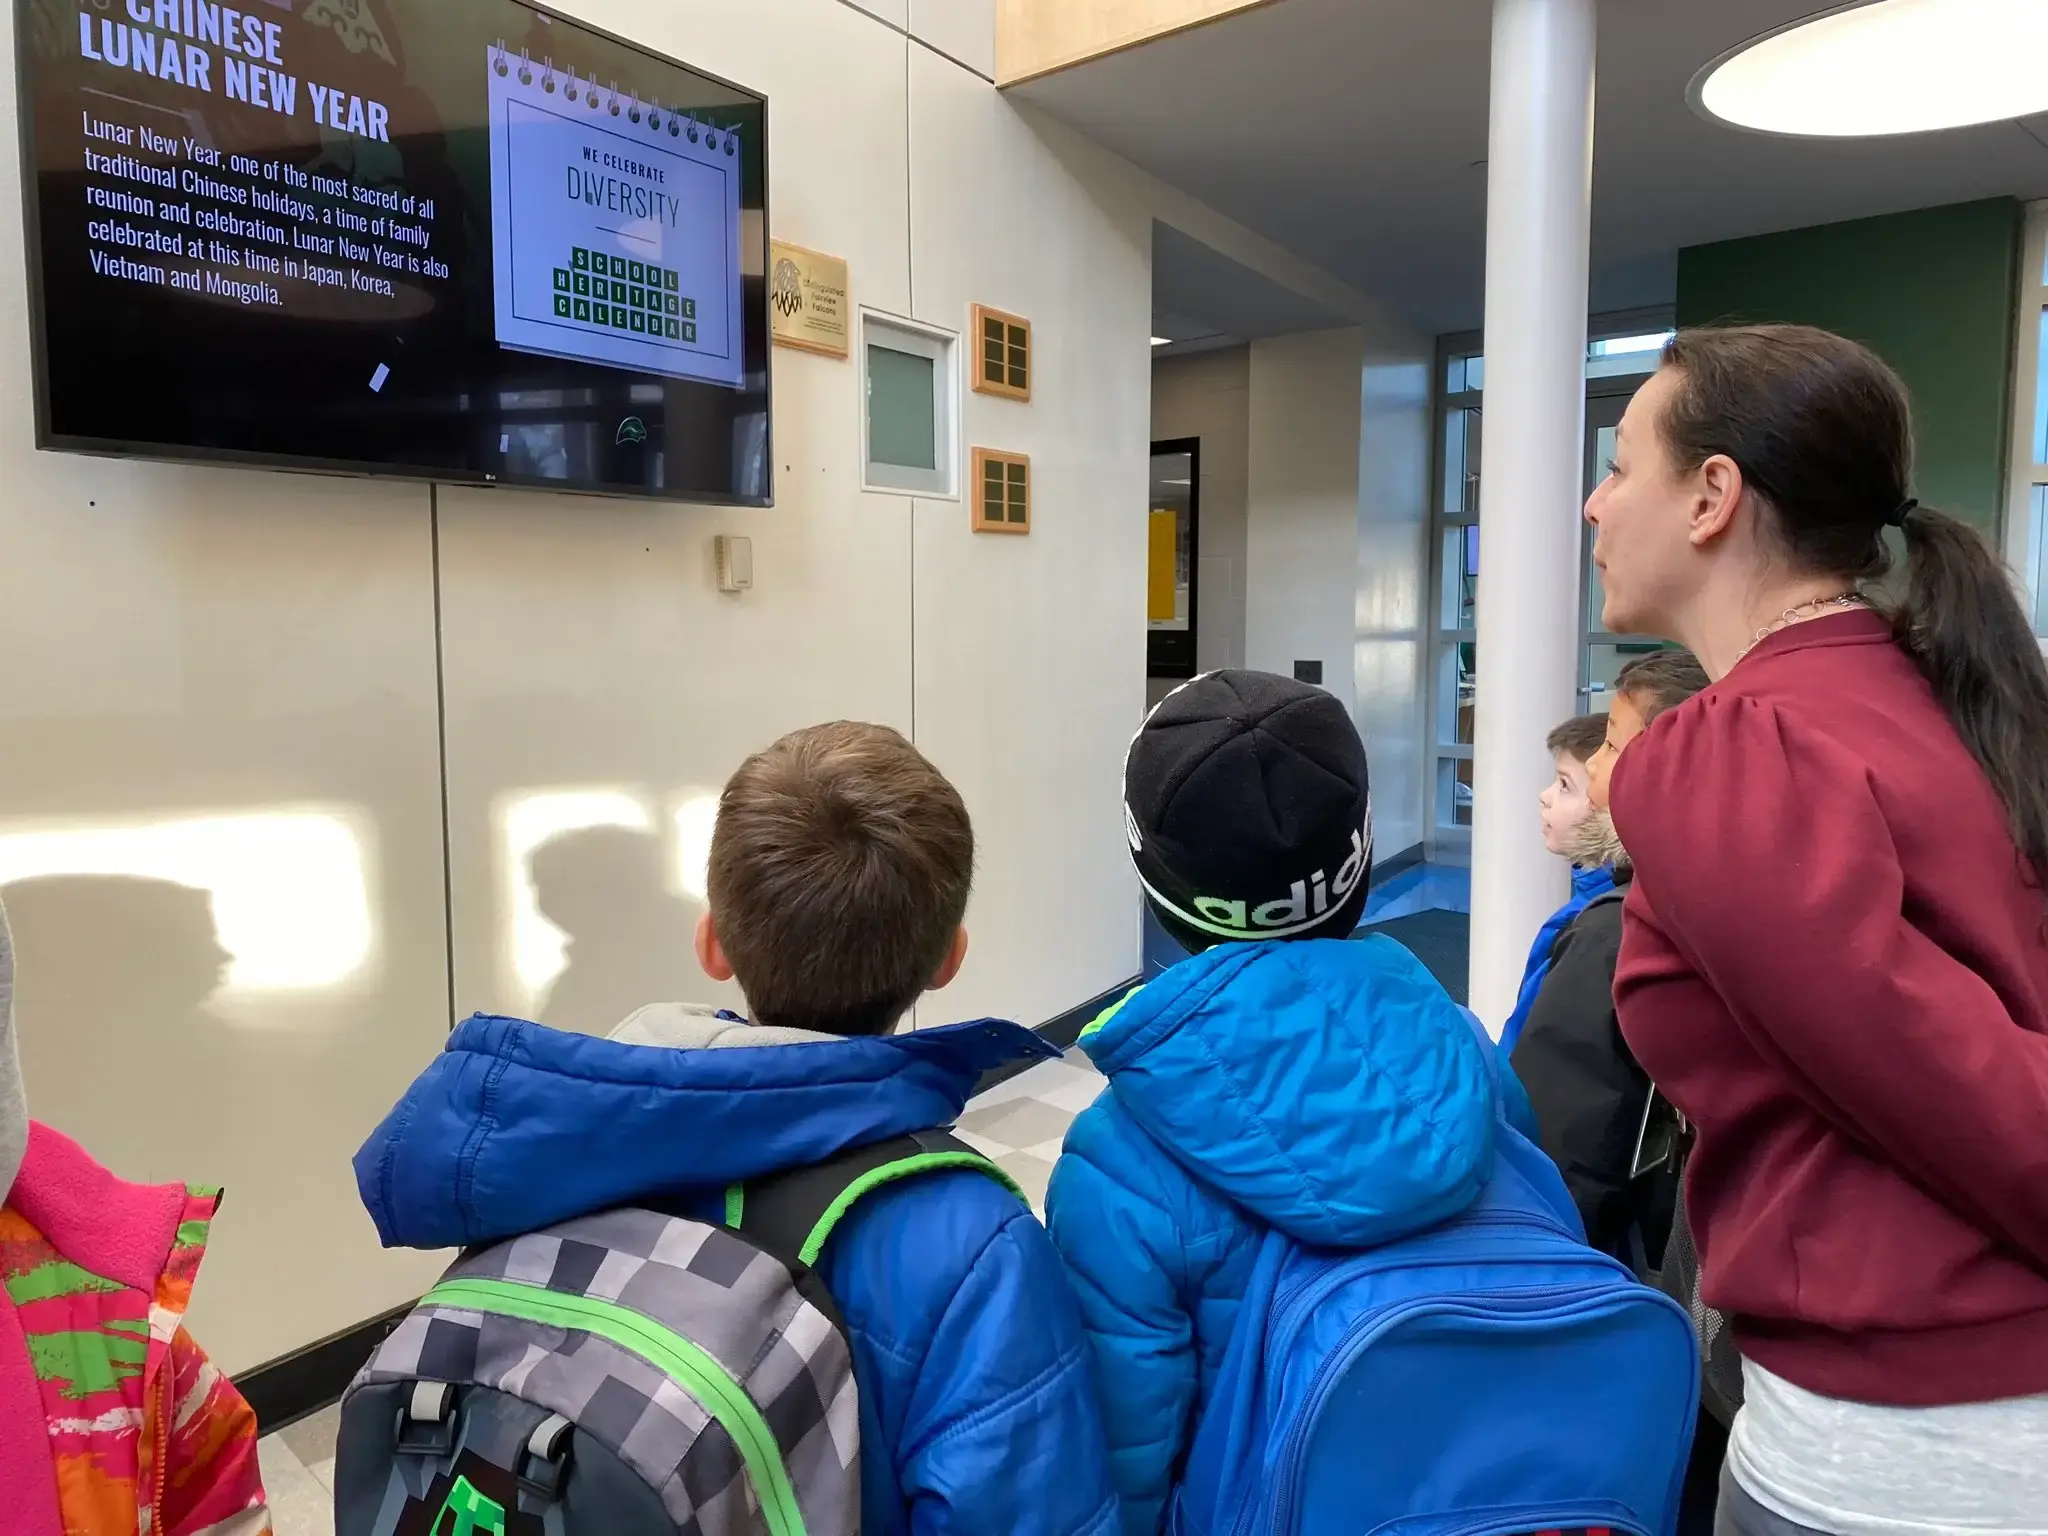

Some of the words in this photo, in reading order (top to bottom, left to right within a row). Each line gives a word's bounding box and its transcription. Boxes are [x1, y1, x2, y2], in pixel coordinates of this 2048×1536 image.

[80, 12, 211, 92] LUNAR
[224, 56, 297, 116] NEW
[307, 81, 390, 144] YEAR
[83, 111, 134, 146] Lunar
[140, 125, 178, 157] New
[183, 136, 226, 171] Year,
[231, 155, 259, 177] one
[264, 161, 279, 182] of
[284, 164, 307, 189] the
[312, 175, 349, 199] most
[352, 186, 398, 211] sacred
[402, 196, 415, 215] of
[419, 199, 434, 220] all
[84, 147, 177, 190] traditional
[182, 169, 247, 205] Chinese
[252, 186, 318, 224] holidays,
[323, 208, 331, 225] a
[336, 207, 367, 233] time
[371, 217, 385, 237] of
[389, 219, 430, 249] family
[568, 166, 679, 228] DIVERSITY
[583, 146, 598, 163] WE
[604, 153, 664, 184] CELEBRATE
[87, 186, 154, 217] reunion
[159, 202, 190, 225] and
[196, 208, 289, 246] celebration.
[293, 226, 334, 255] Lunar
[339, 236, 369, 263] New
[373, 244, 404, 270] Year
[408, 253, 420, 273] is
[423, 256, 448, 279] also
[88, 219, 182, 256] celebrated
[188, 239, 204, 260] at
[208, 241, 239, 267] this
[244, 248, 279, 274] time
[284, 256, 297, 278] in
[302, 259, 347, 289] Japan,
[351, 268, 395, 298] Korea,
[90, 249, 165, 285] Vietnam
[170, 269, 200, 291] and
[206, 271, 283, 306] Mongolia.
[557, 272, 693, 315] HERITAGE
[576, 251, 675, 288] SCHOOL
[557, 298, 694, 339] CALENDAR
[1194, 802, 1371, 929] adid
